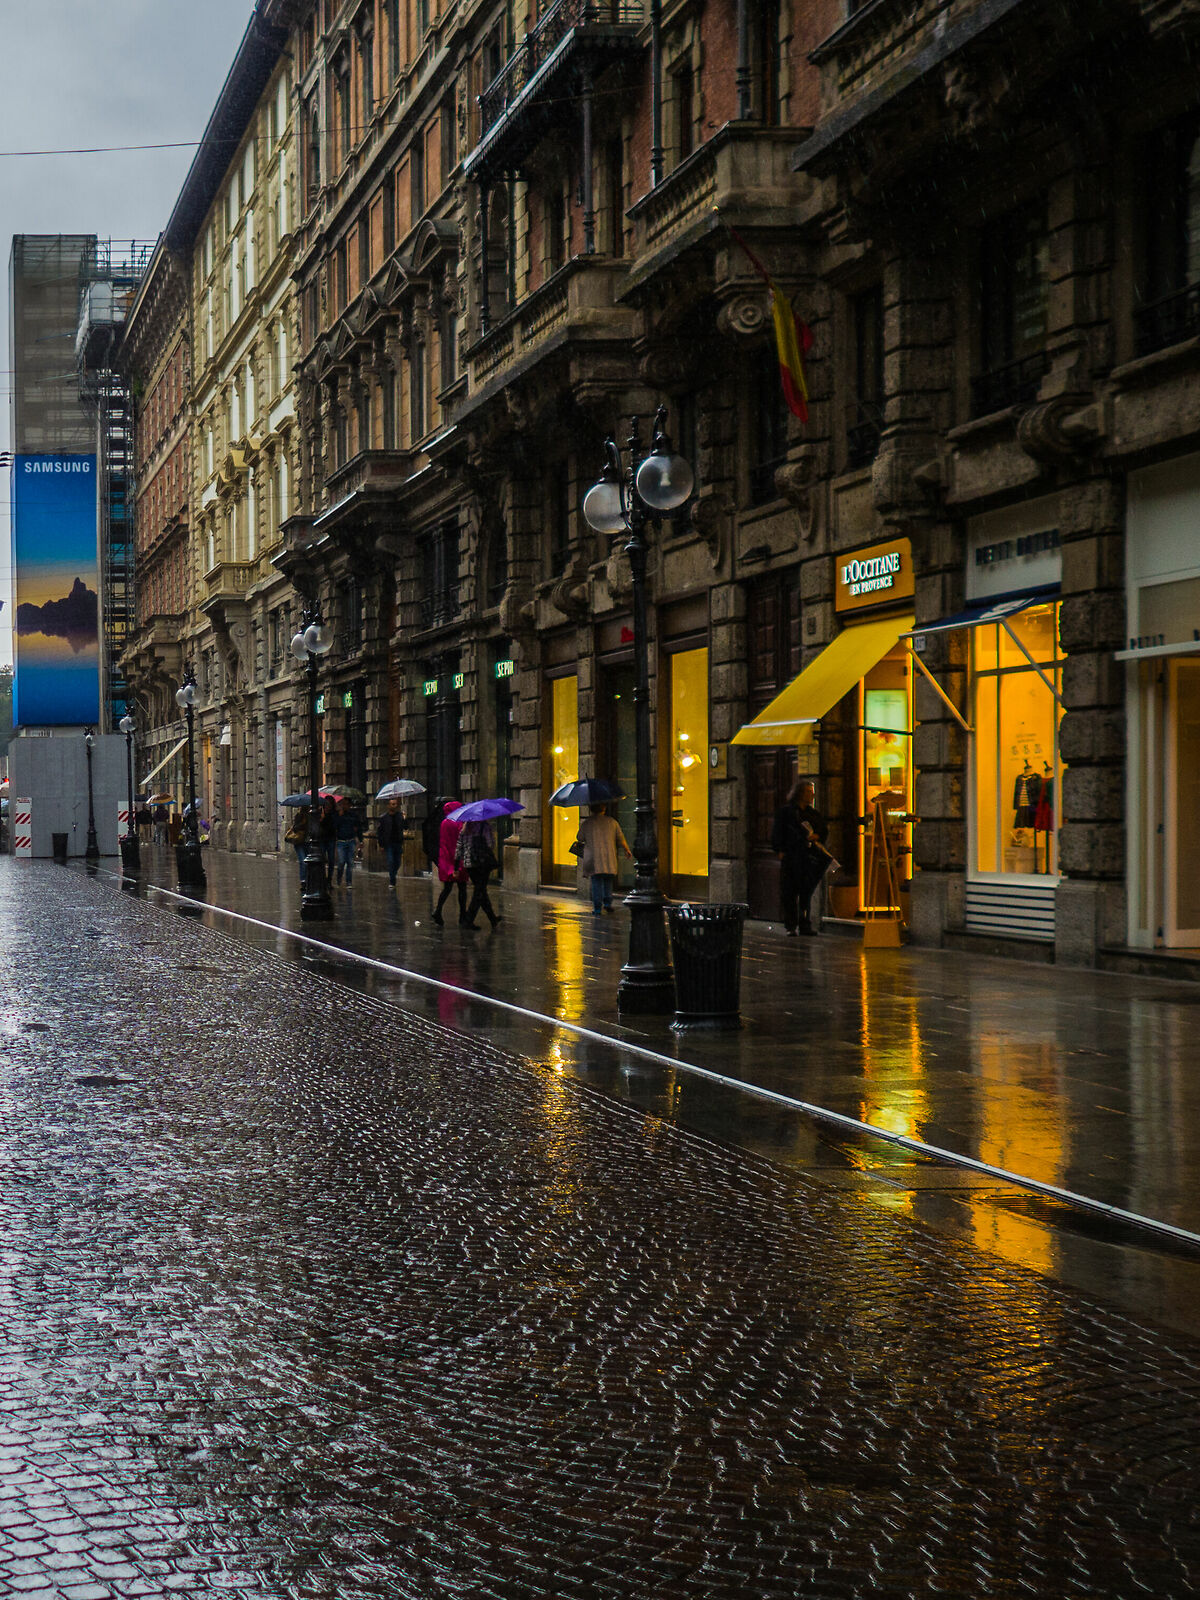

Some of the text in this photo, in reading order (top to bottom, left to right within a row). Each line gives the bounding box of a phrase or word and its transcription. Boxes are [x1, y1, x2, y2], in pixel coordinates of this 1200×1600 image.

[23, 461, 91, 473] SAMSUNG
[841, 552, 901, 586] L'OCCITANE
[848, 575, 894, 597] EN PROVENCE
